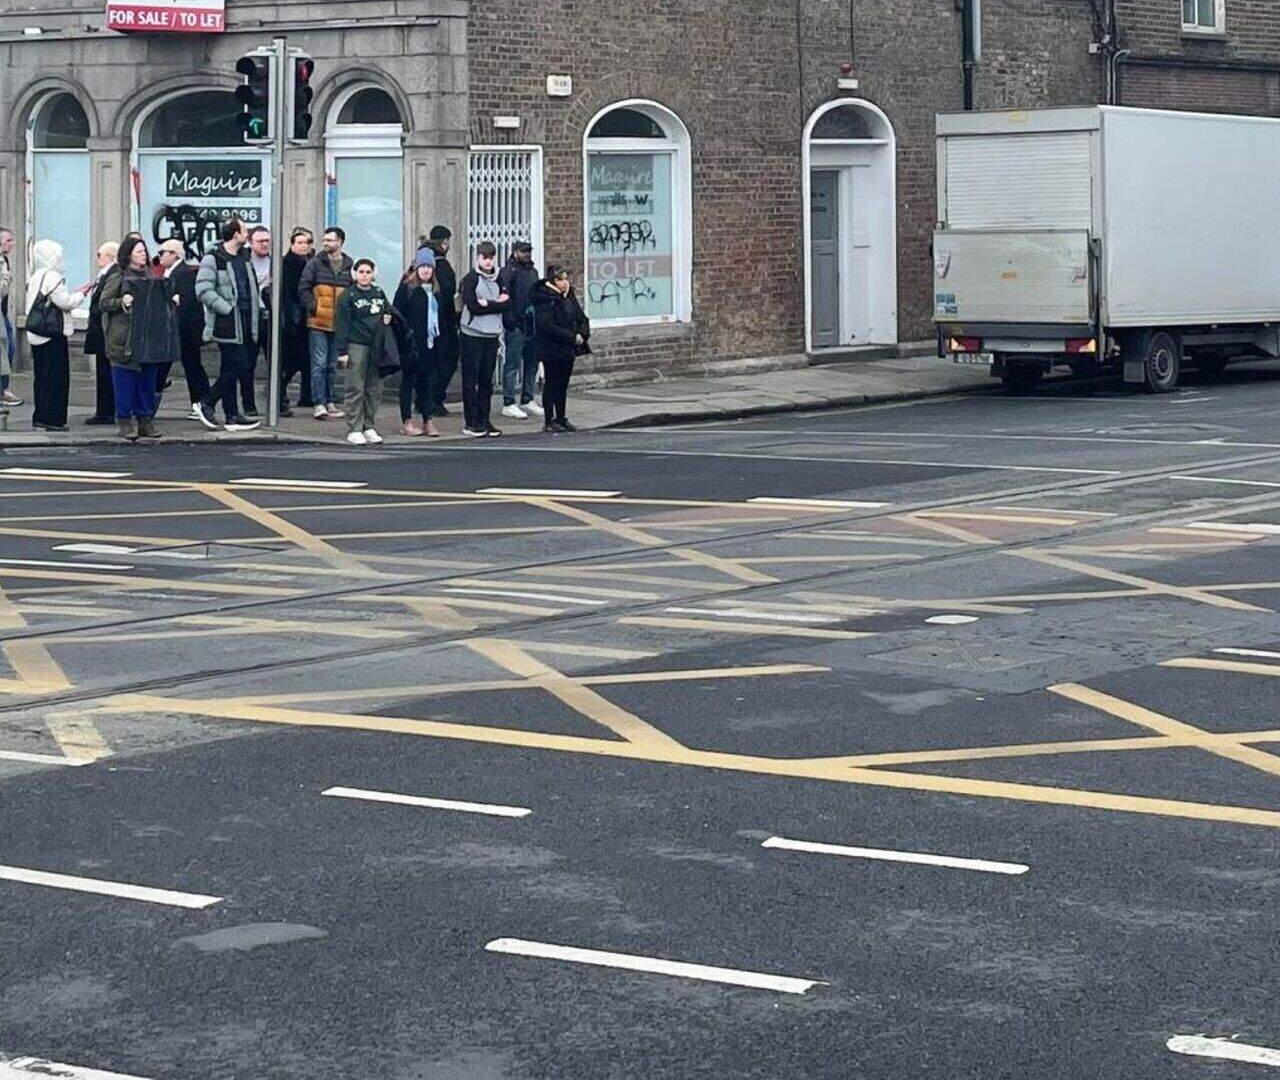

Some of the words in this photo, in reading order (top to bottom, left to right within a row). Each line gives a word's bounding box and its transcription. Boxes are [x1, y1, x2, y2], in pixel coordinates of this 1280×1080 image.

[109, 10, 135, 24] FOR
[138, 11, 169, 25] SALE
[180, 13, 197, 26] TO
[200, 14, 222, 27] LET
[168, 170, 261, 195] Maguire
[591, 166, 653, 189] Maguire
[589, 262, 617, 279] TO
[625, 259, 656, 277] LET
